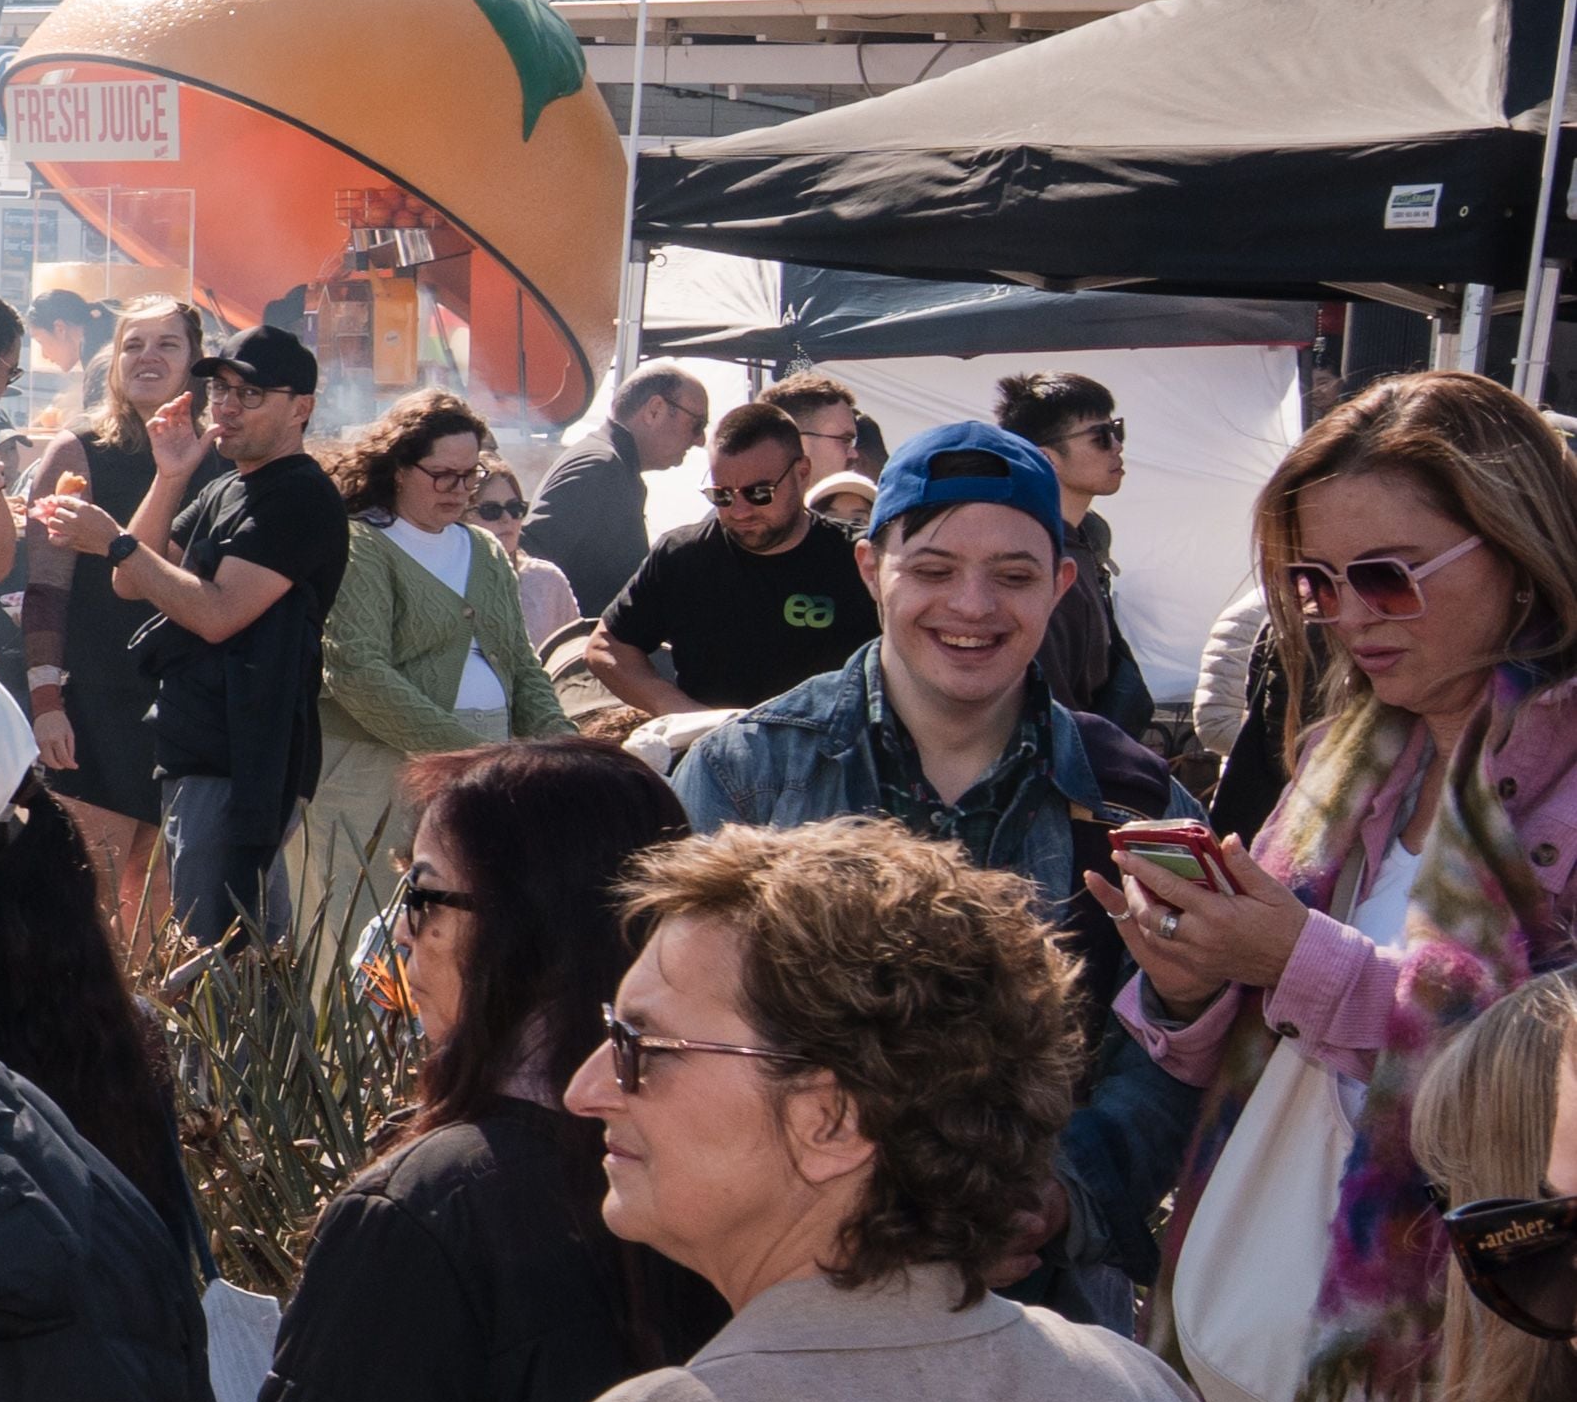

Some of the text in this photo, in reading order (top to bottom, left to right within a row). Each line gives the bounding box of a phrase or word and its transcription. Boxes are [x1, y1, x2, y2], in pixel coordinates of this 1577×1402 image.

[13, 84, 168, 144] FRESH JUICE
[1484, 1219, 1546, 1249] archer
